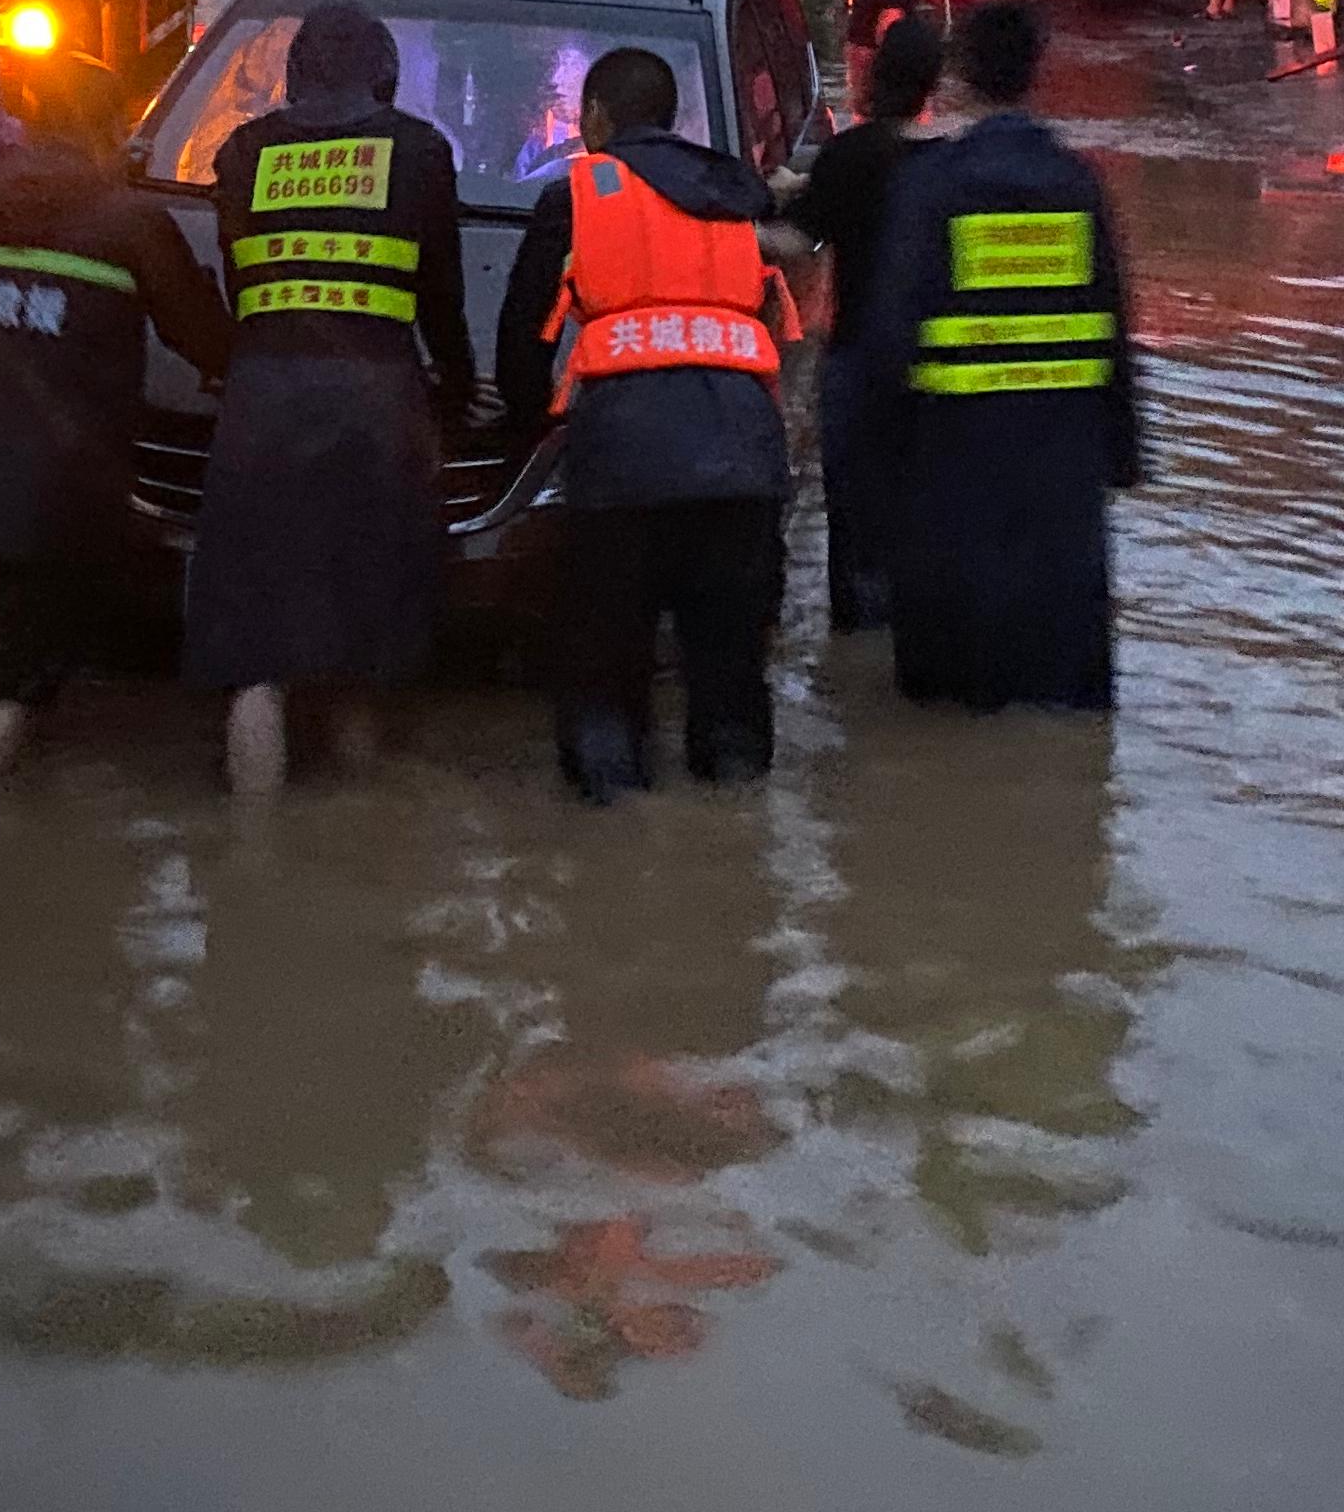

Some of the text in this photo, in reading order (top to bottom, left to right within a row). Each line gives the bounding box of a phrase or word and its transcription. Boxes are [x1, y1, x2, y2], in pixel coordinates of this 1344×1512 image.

[273, 146, 375, 172] 共城救援
[267, 175, 375, 200] 6666699
[608, 313, 759, 359] 共城救援
